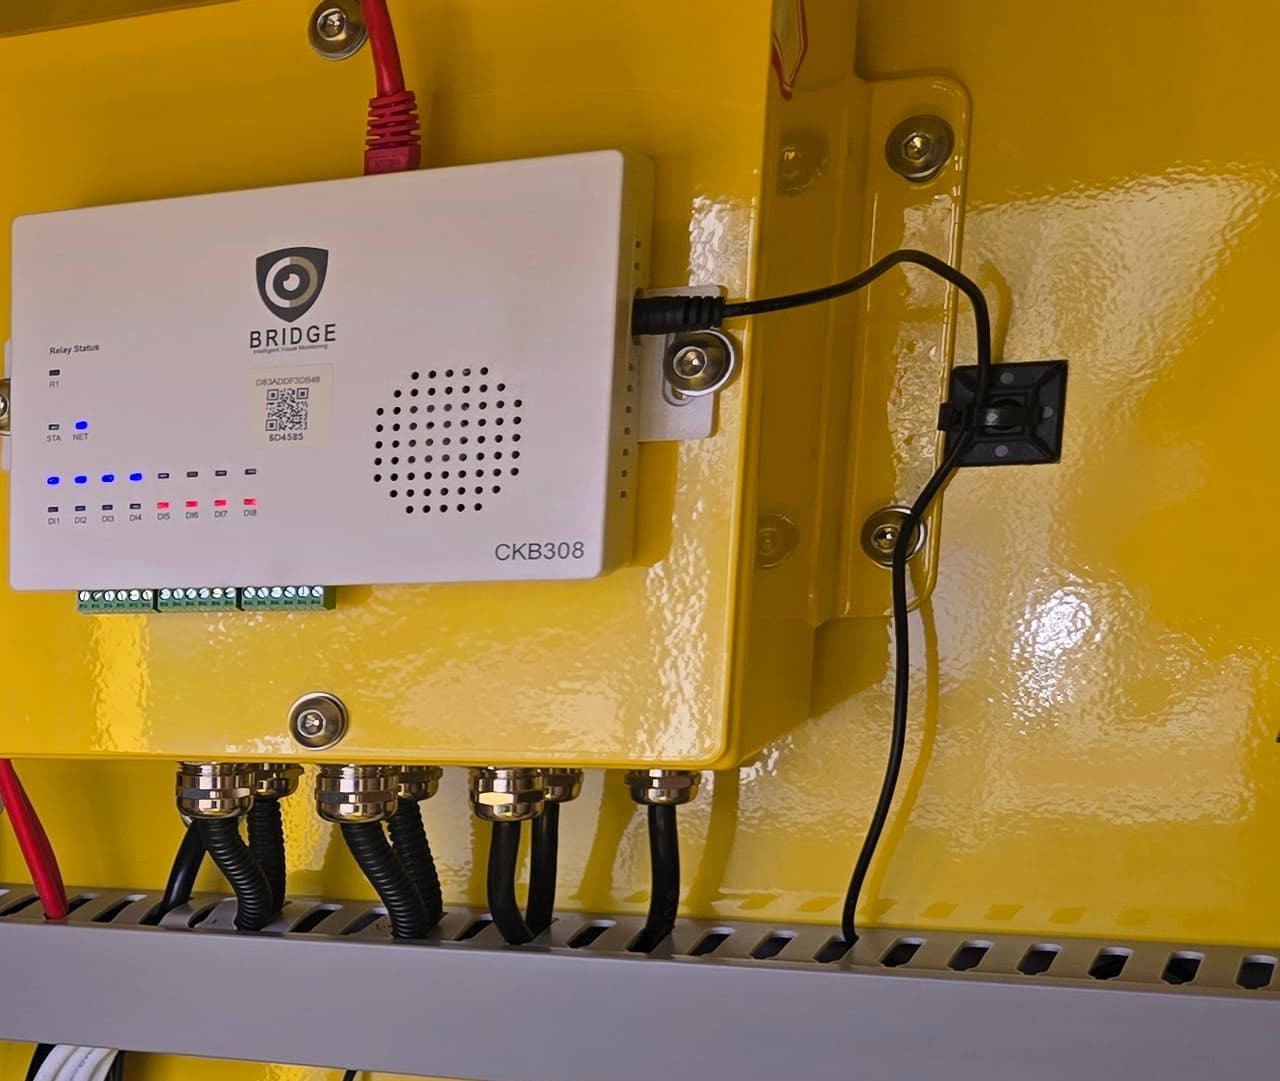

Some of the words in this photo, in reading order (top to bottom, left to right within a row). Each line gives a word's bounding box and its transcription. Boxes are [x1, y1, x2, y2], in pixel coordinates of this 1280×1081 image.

[250, 323, 336, 349] BRIDGE
[50, 346, 72, 355] Relay
[74, 344, 99, 353] Status
[46, 434, 61, 442] STA
[73, 433, 88, 441] NET
[495, 541, 584, 561] CKB308
